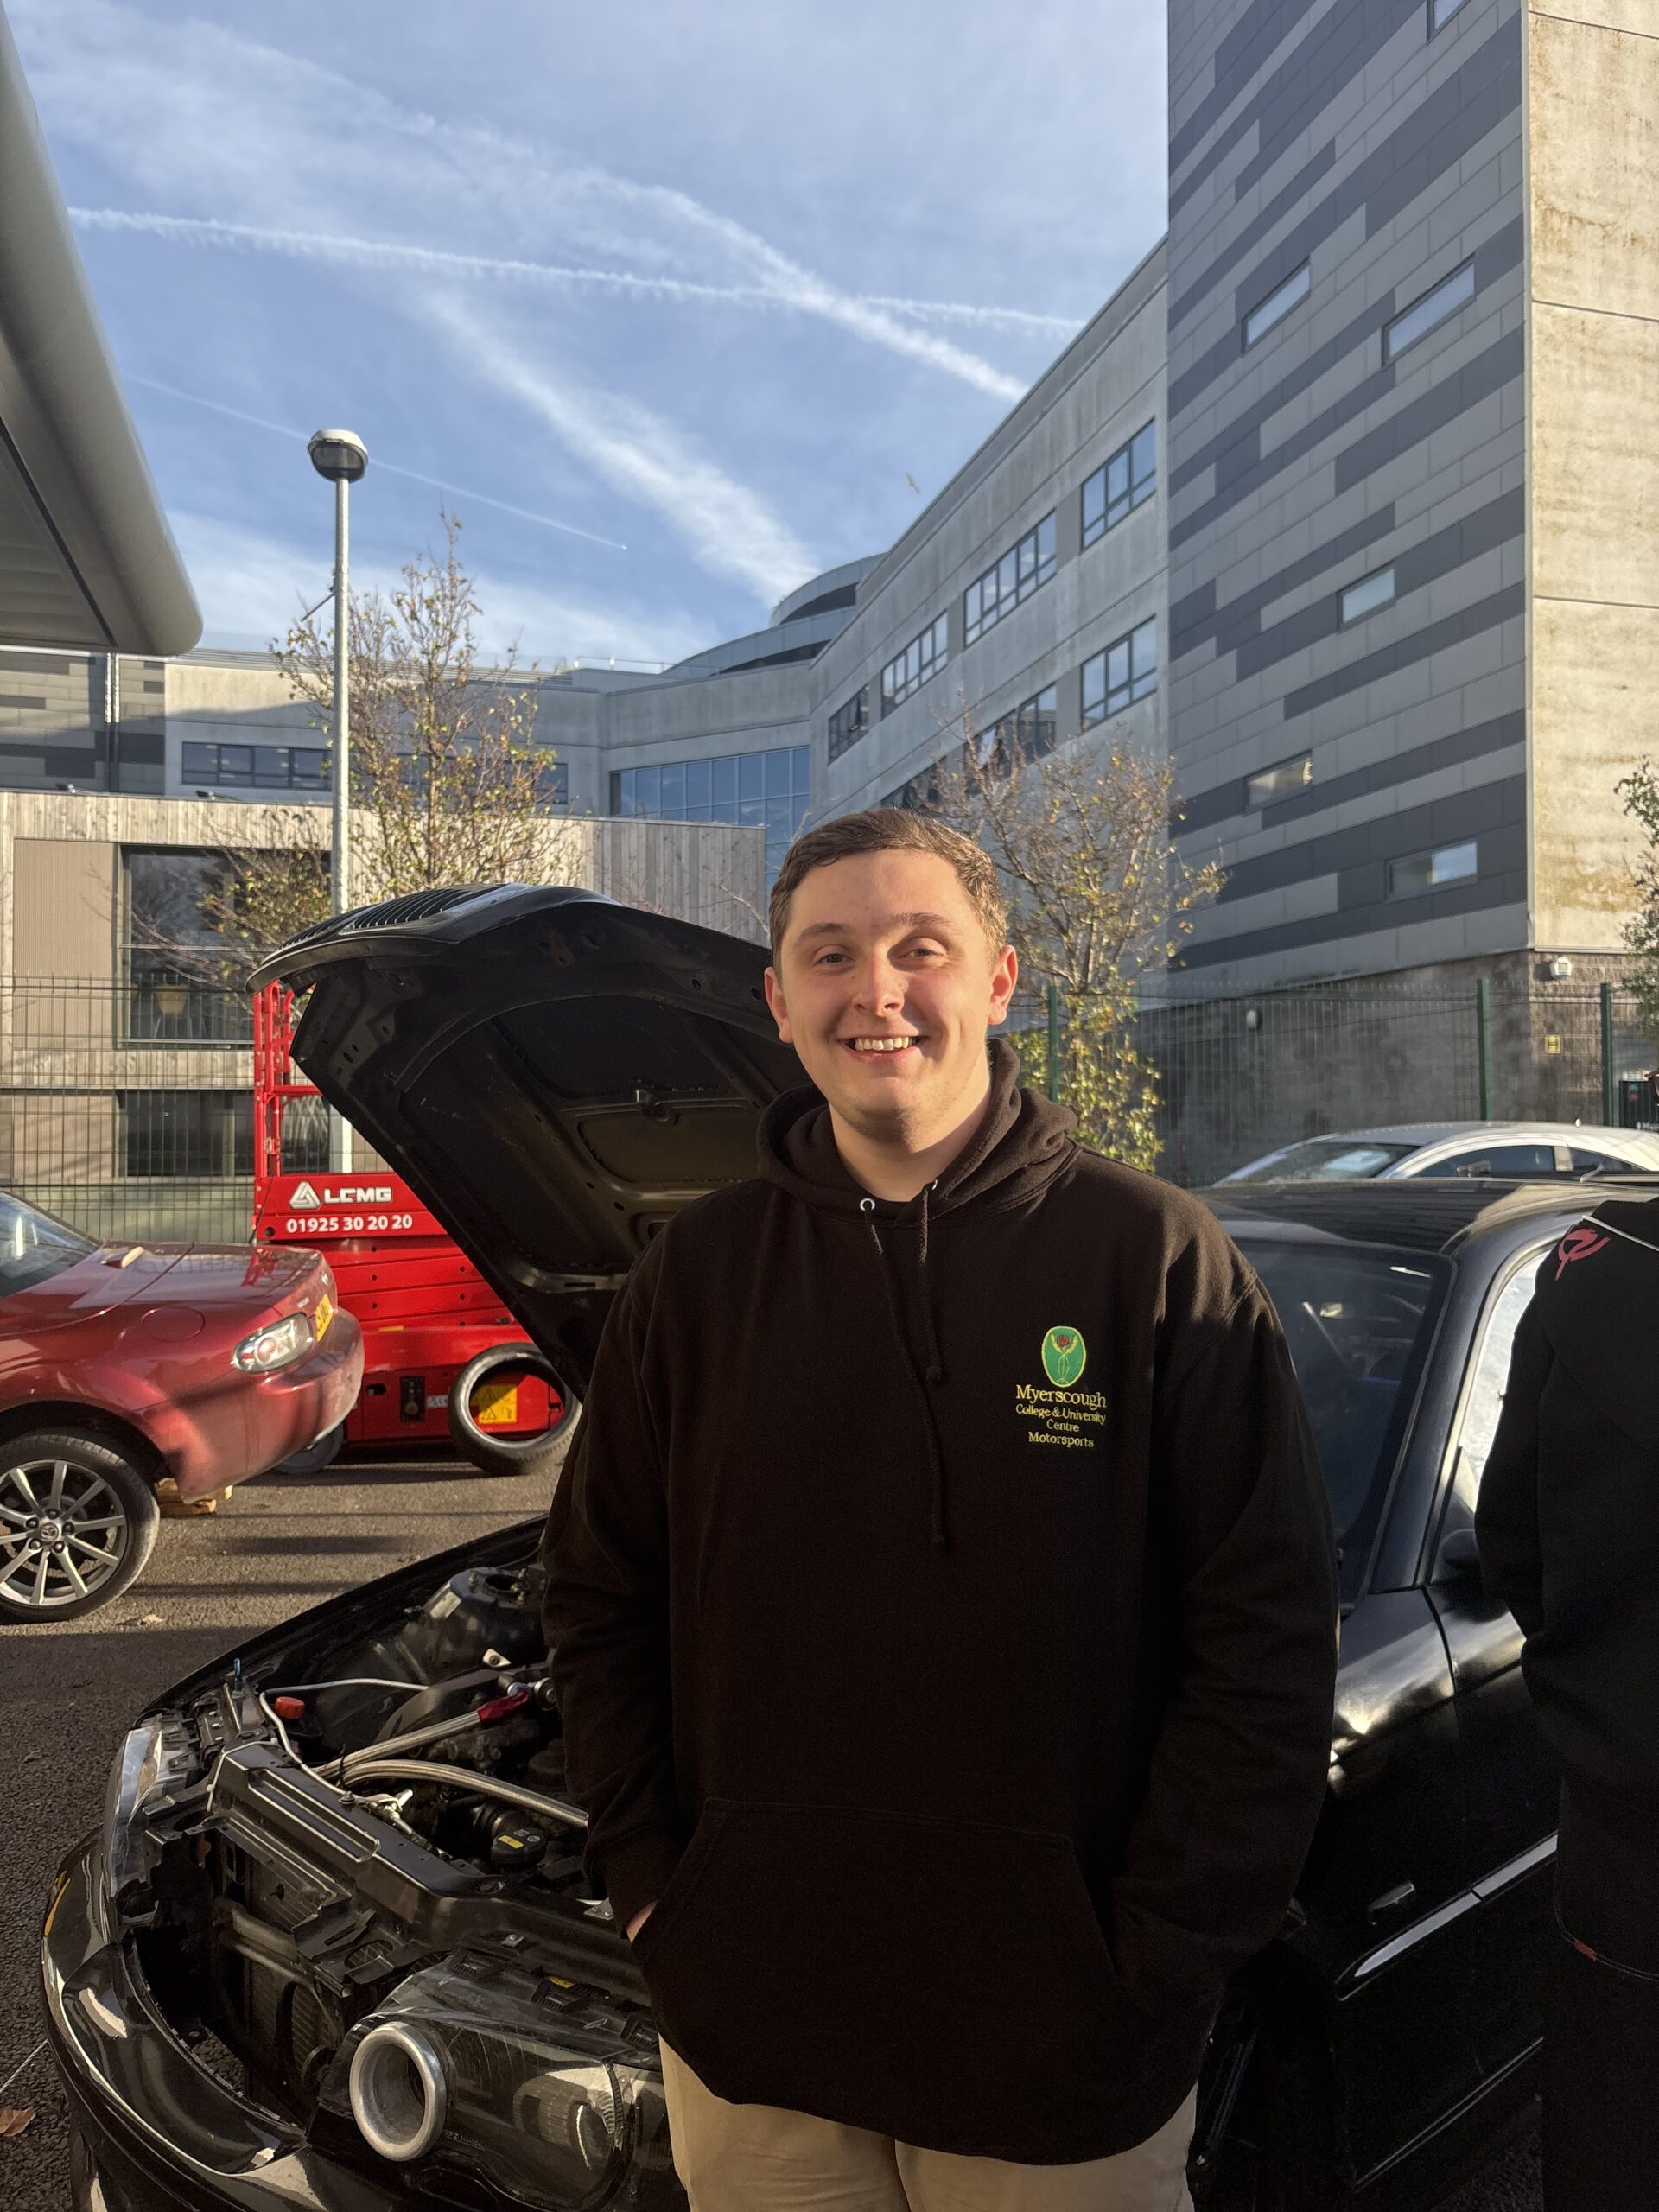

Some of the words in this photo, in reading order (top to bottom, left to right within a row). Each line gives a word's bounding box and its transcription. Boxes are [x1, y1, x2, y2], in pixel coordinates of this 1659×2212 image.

[324, 1187, 392, 1204] LCMG
[287, 1217, 339, 1233] 01925
[343, 1216, 364, 1231] 30
[367, 1215, 388, 1230] 20
[391, 1214, 413, 1229] 20
[1015, 1384, 1107, 1410] Myerscough
[1015, 1403, 1051, 1419] College
[1052, 1407, 1061, 1417] &
[1062, 1407, 1106, 1425] University
[1046, 1418, 1080, 1432] Centre
[1027, 1431, 1095, 1448] Motorsports
